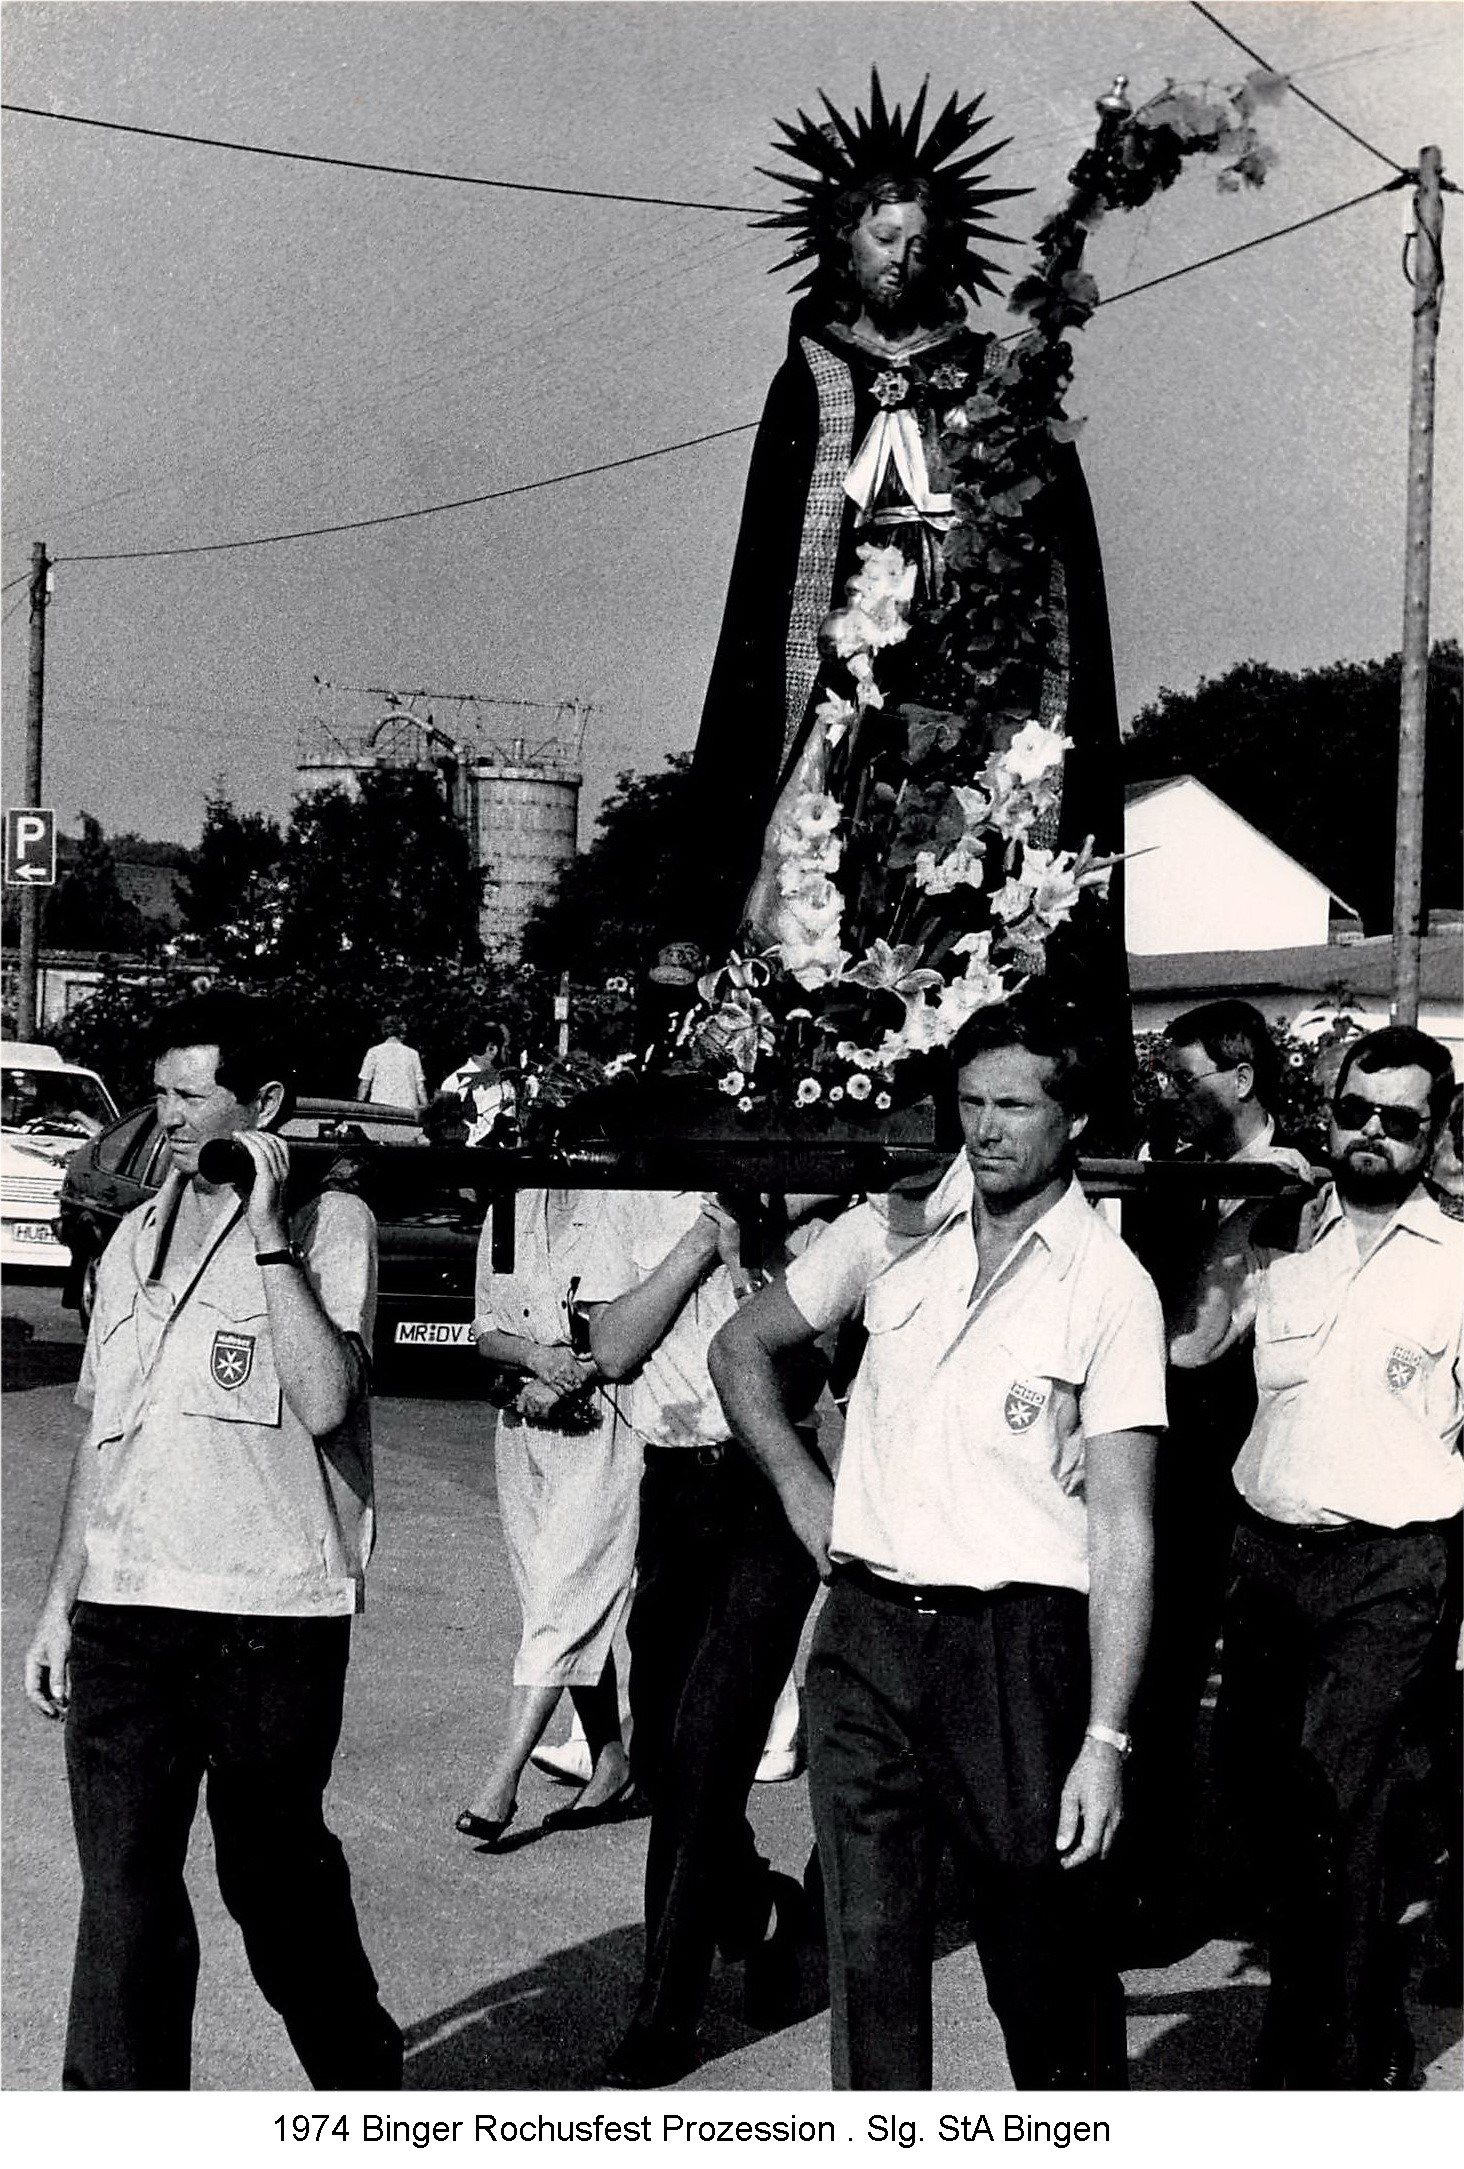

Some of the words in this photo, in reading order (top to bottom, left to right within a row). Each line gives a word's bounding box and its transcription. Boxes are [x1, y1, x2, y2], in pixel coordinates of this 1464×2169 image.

[17, 816, 45, 859] P
[400, 1324, 427, 1342] MR
[436, 1325, 463, 1342] DV
[1011, 1384, 1045, 1405] MHD
